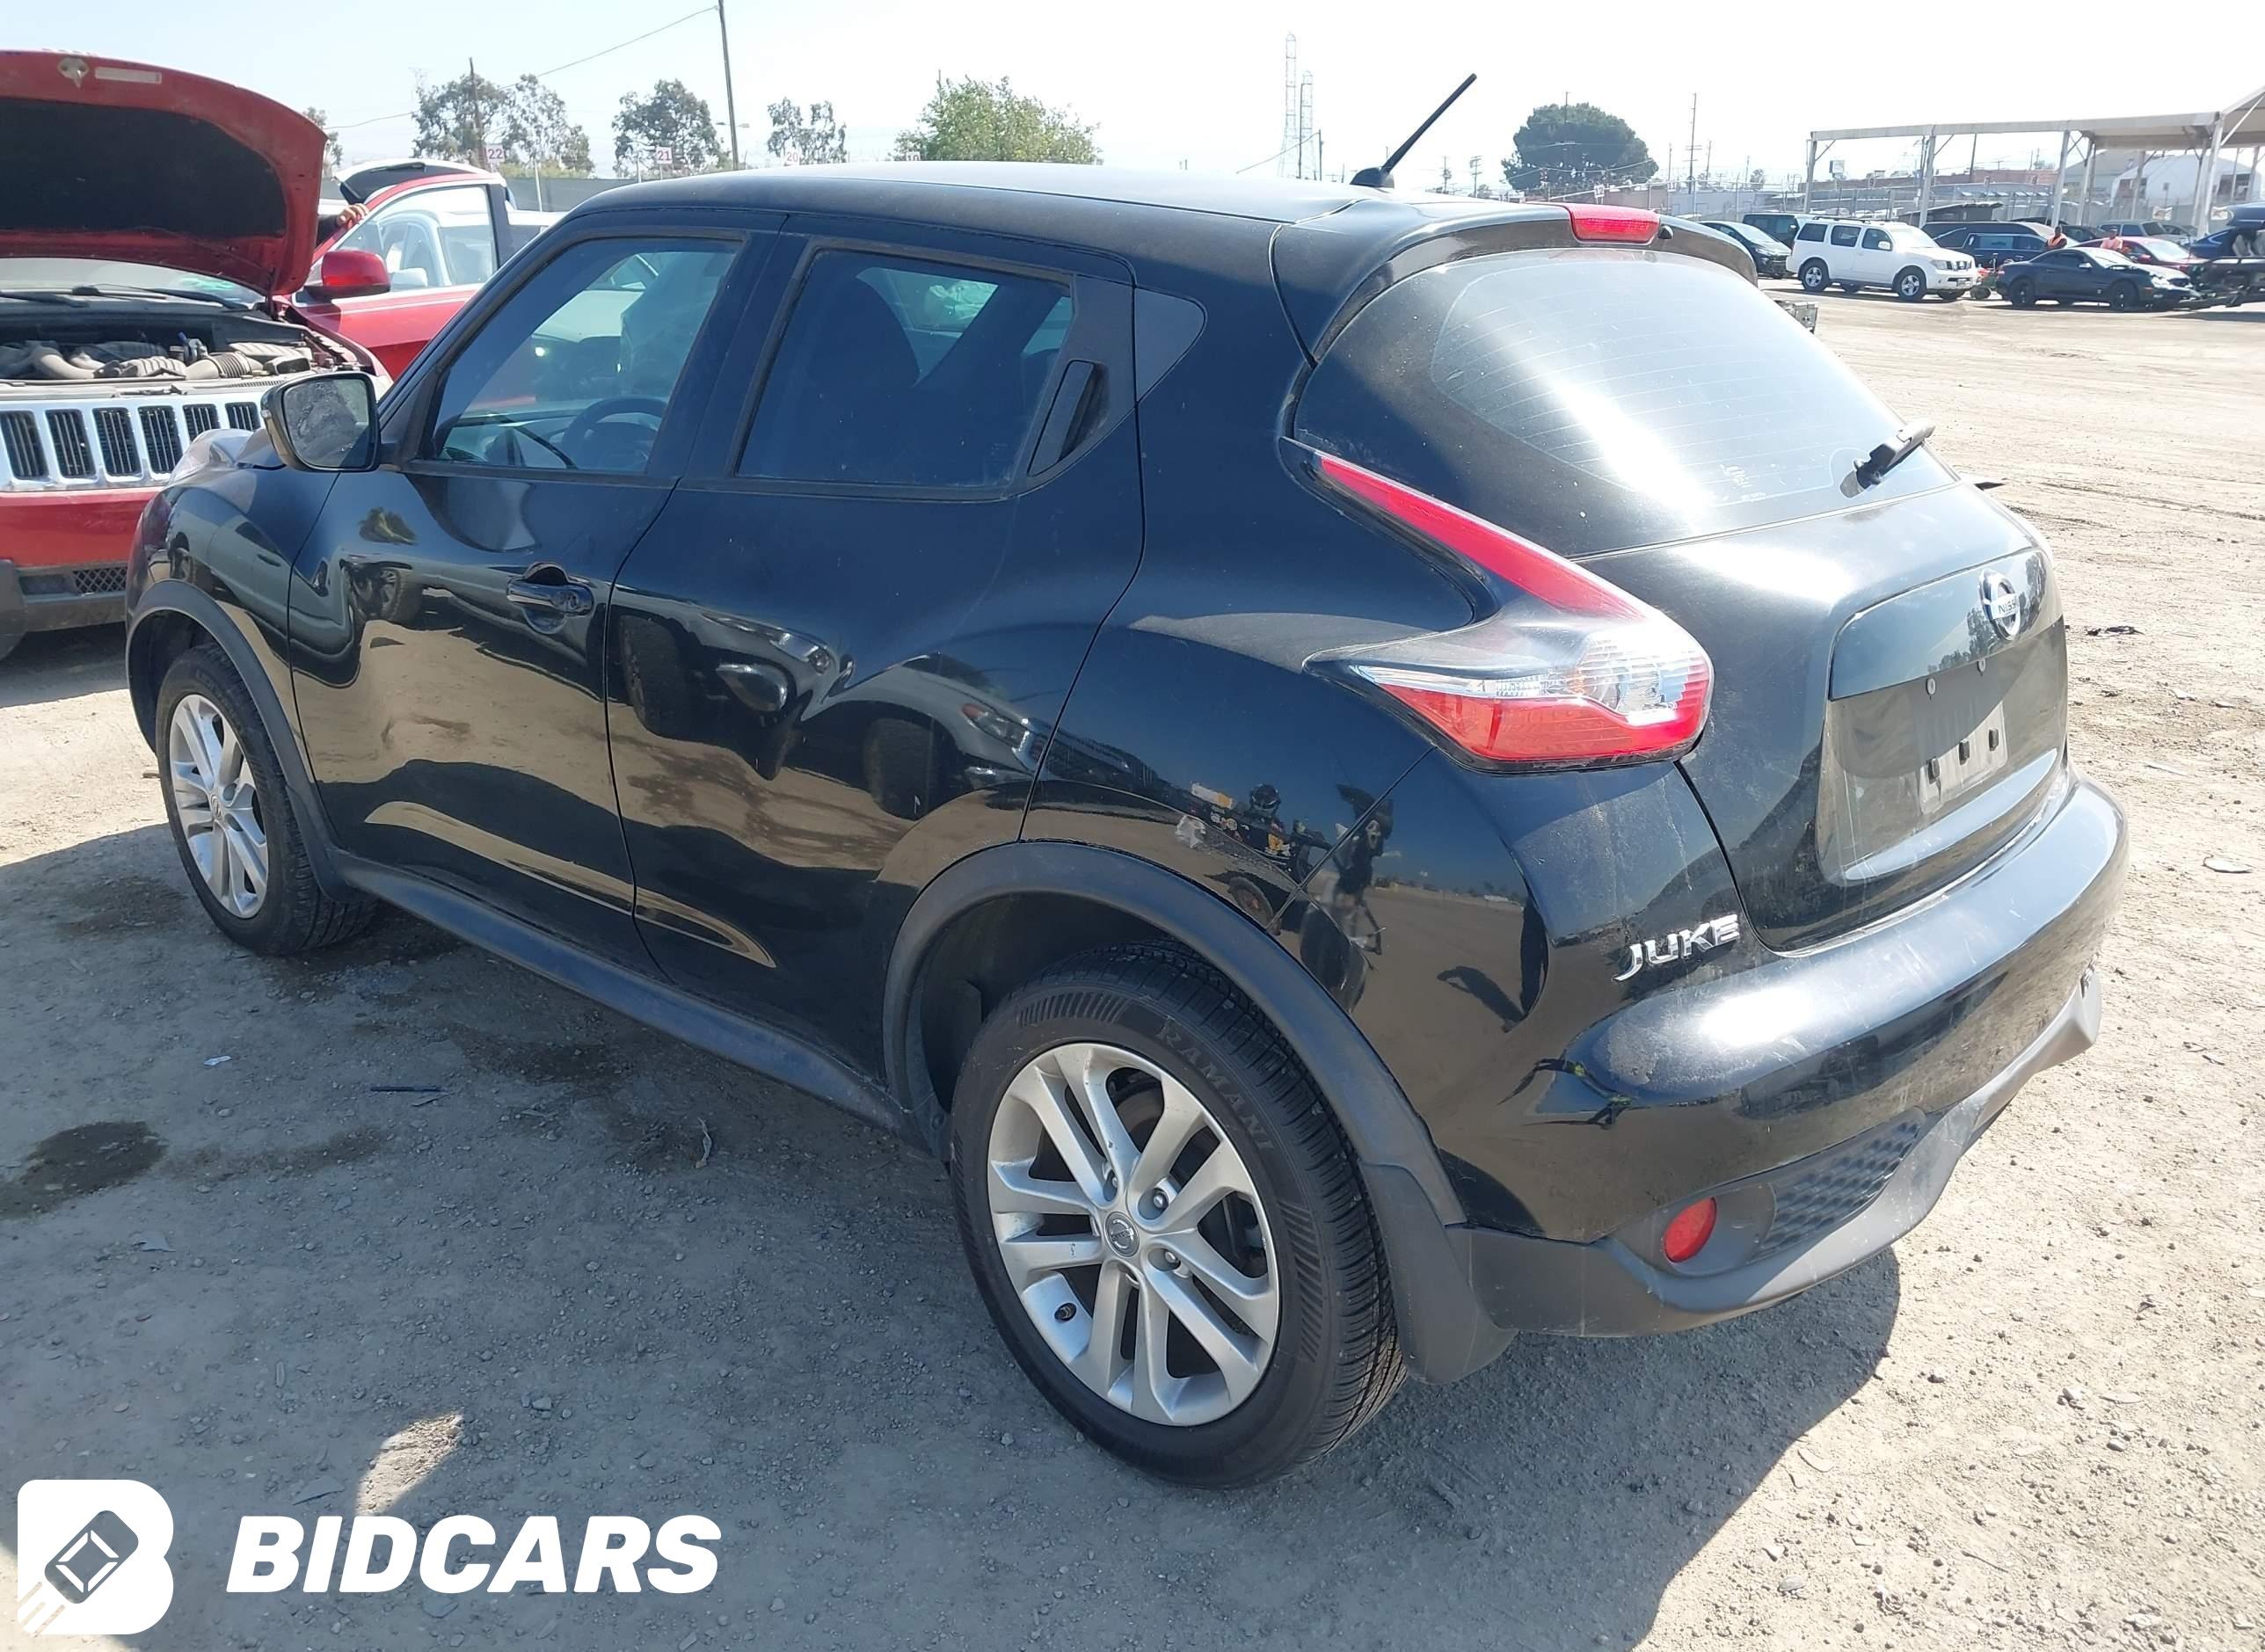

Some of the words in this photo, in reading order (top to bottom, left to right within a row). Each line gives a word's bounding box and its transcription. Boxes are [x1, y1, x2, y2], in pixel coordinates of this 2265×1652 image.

[487, 148, 503, 159] 22
[657, 149, 671, 161] 21
[786, 151, 798, 163] 20
[1613, 913, 1740, 982] JUKE
